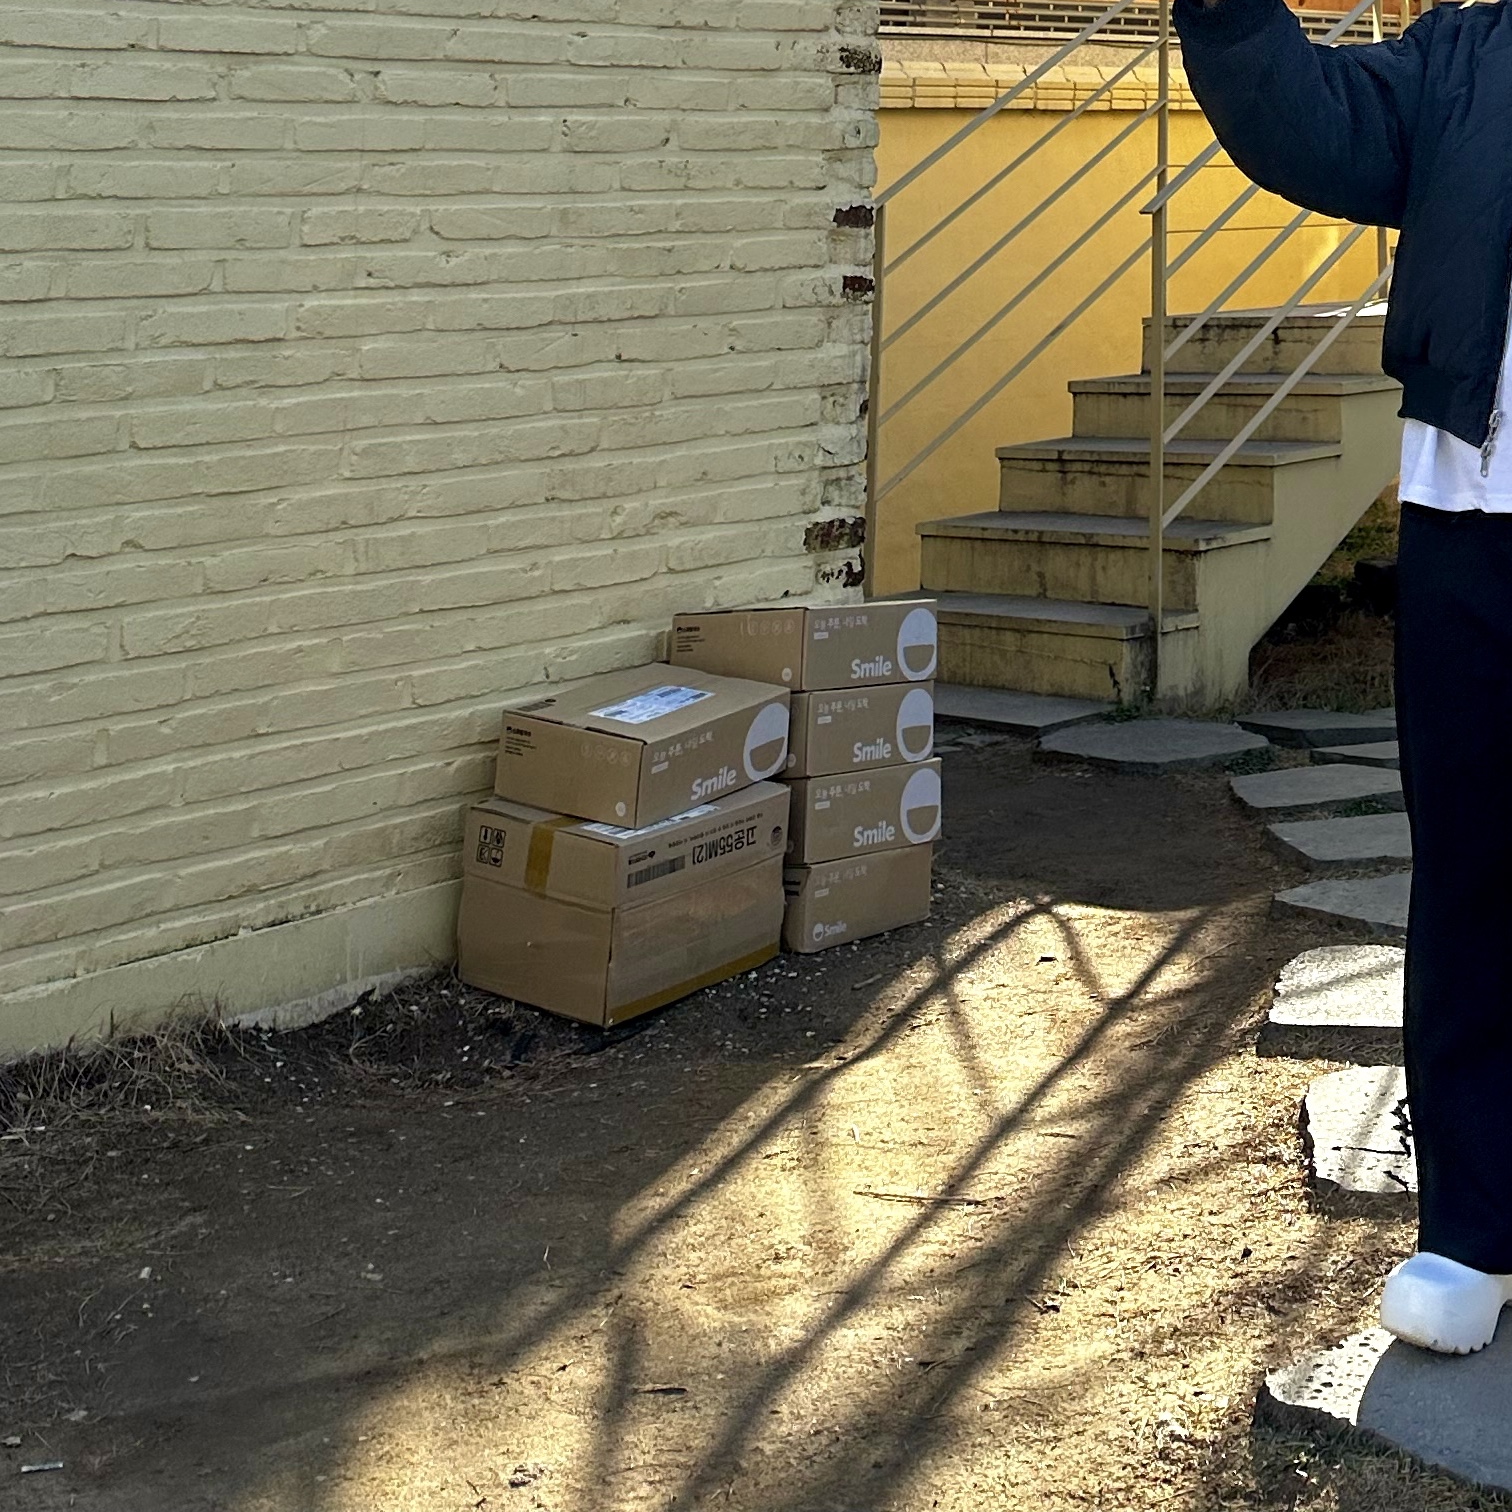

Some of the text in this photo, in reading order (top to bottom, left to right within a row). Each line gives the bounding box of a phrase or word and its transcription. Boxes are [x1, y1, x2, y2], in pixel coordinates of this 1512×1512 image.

[851, 655, 892, 679] Smile
[853, 737, 892, 763] Smile
[690, 765, 737, 801] Smile
[853, 820, 895, 848] Smile
